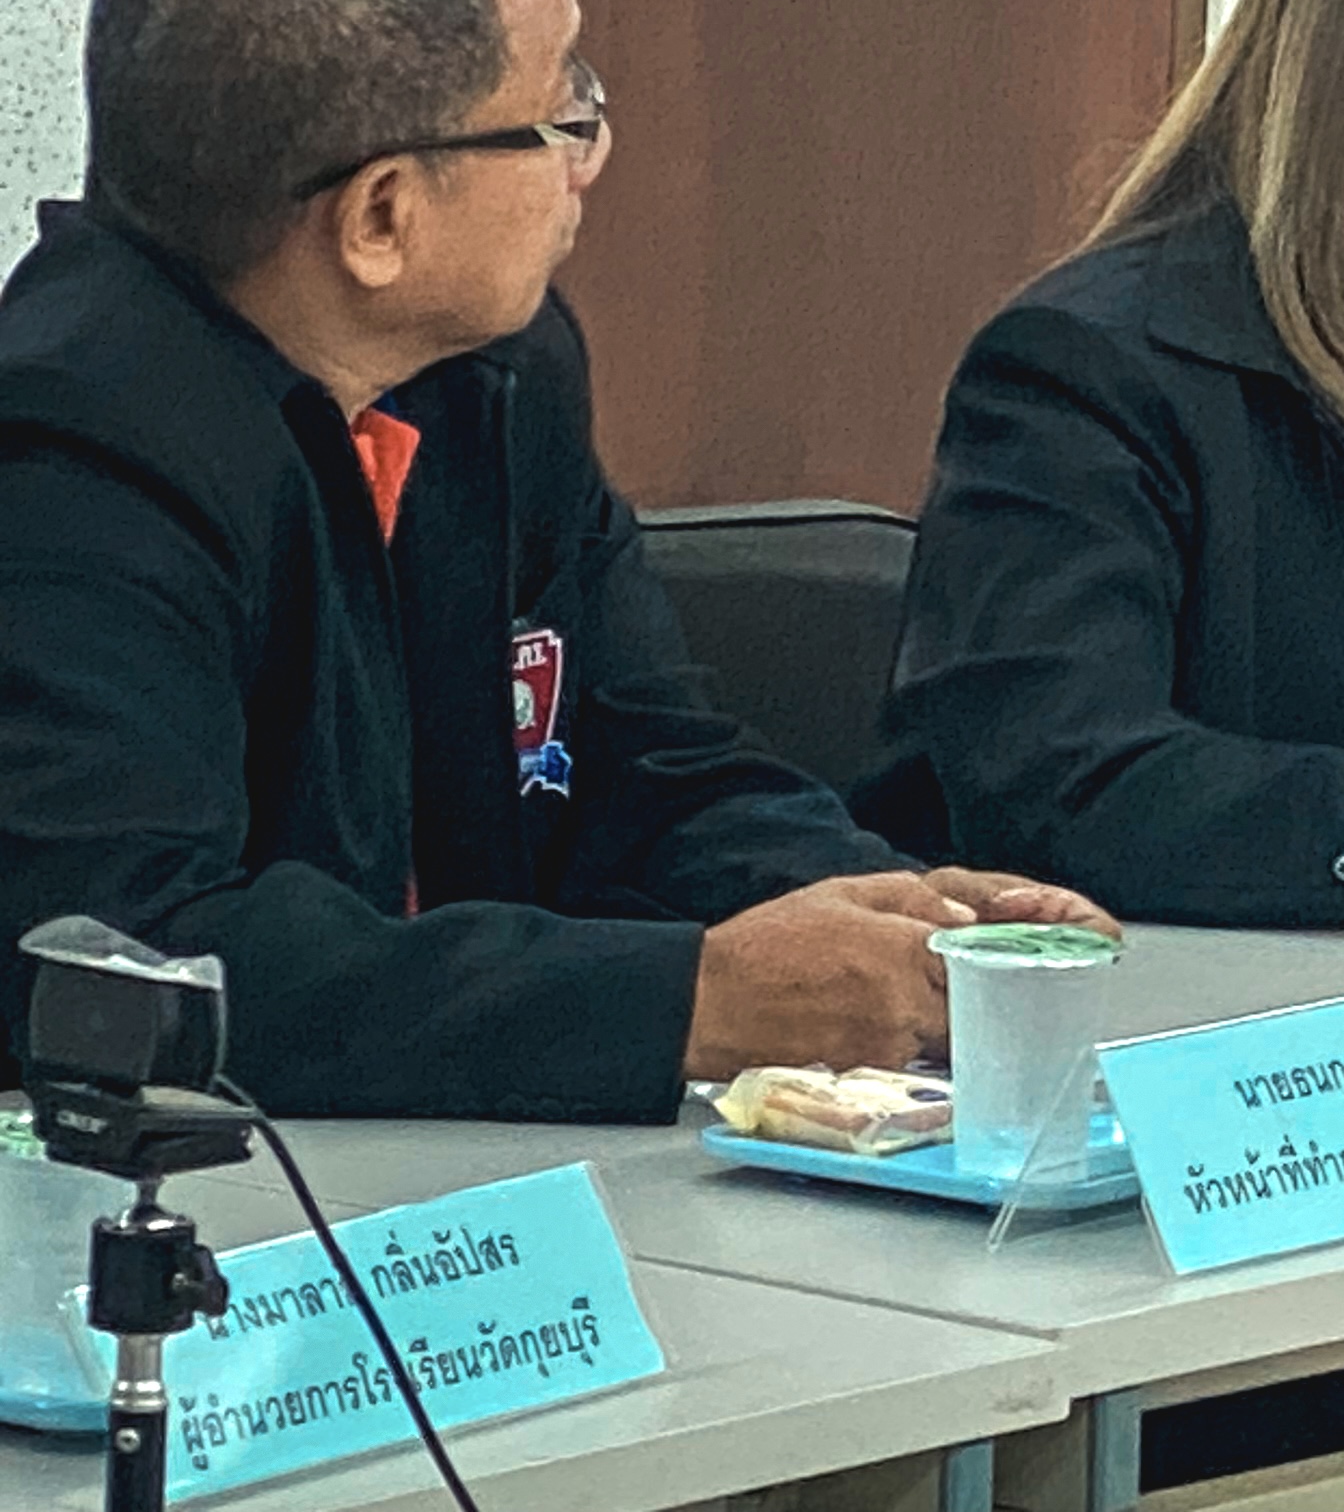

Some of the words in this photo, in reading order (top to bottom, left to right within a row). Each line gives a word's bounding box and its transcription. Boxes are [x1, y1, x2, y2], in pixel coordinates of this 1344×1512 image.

[180, 1296, 602, 1471] ผู้อำนวยการโรเรียนวัดกุยบุรี
